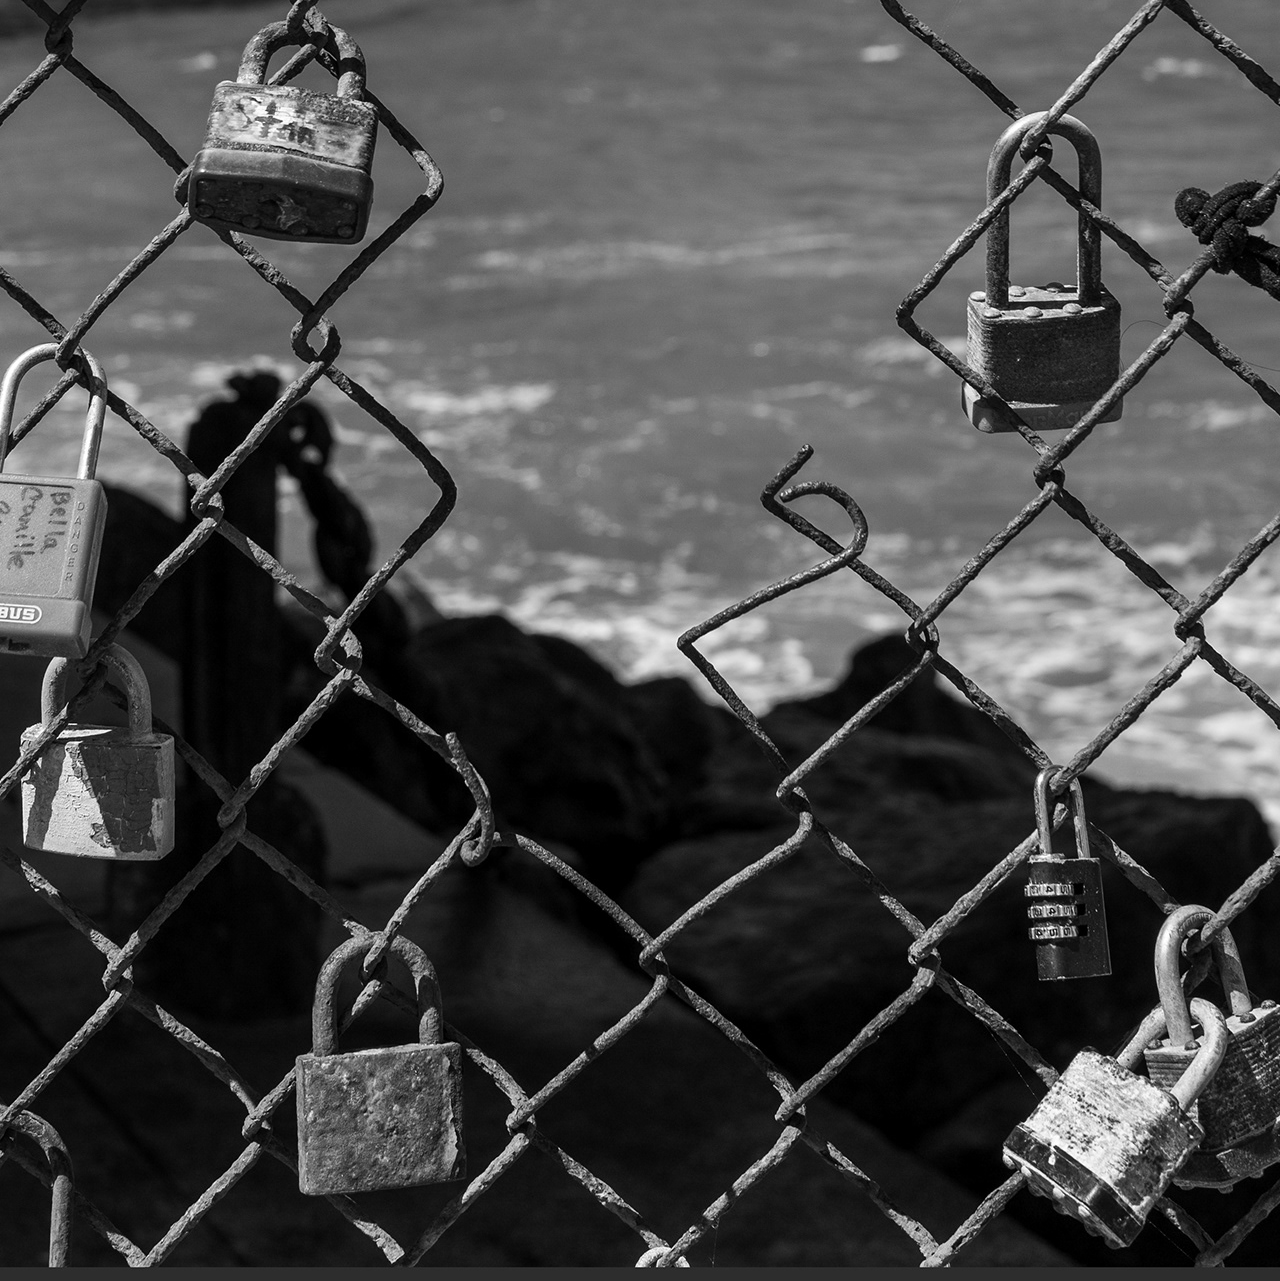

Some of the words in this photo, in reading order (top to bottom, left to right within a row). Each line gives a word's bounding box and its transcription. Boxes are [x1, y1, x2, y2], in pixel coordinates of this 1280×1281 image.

[6, 486, 44, 571] Camille
[40, 492, 71, 554] Bella
[64, 501, 86, 582] DANGER
